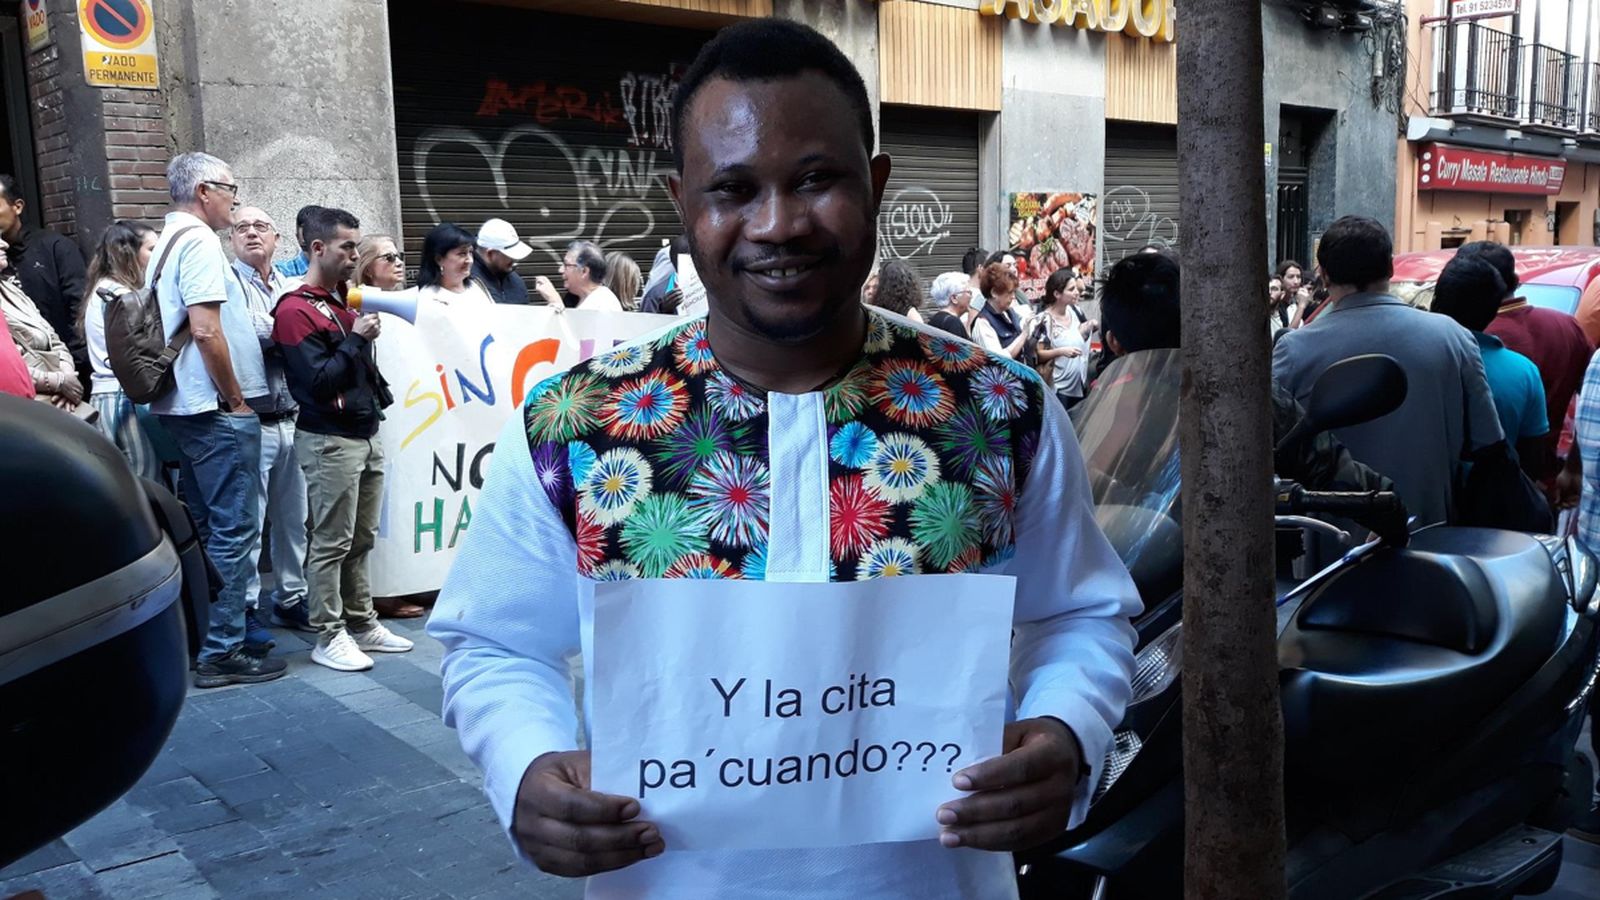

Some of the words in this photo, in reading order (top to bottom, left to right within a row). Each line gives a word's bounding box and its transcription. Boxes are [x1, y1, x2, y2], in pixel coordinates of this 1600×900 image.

[1469, 3, 1477, 12] 91
[89, 69, 156, 82] PERMANENTE
[1437, 155, 1461, 186] Curry
[1459, 158, 1487, 183] Masala
[1488, 161, 1530, 185] Restaurante
[710, 677, 747, 717] Y
[764, 679, 802, 718] la
[821, 672, 896, 715] cita
